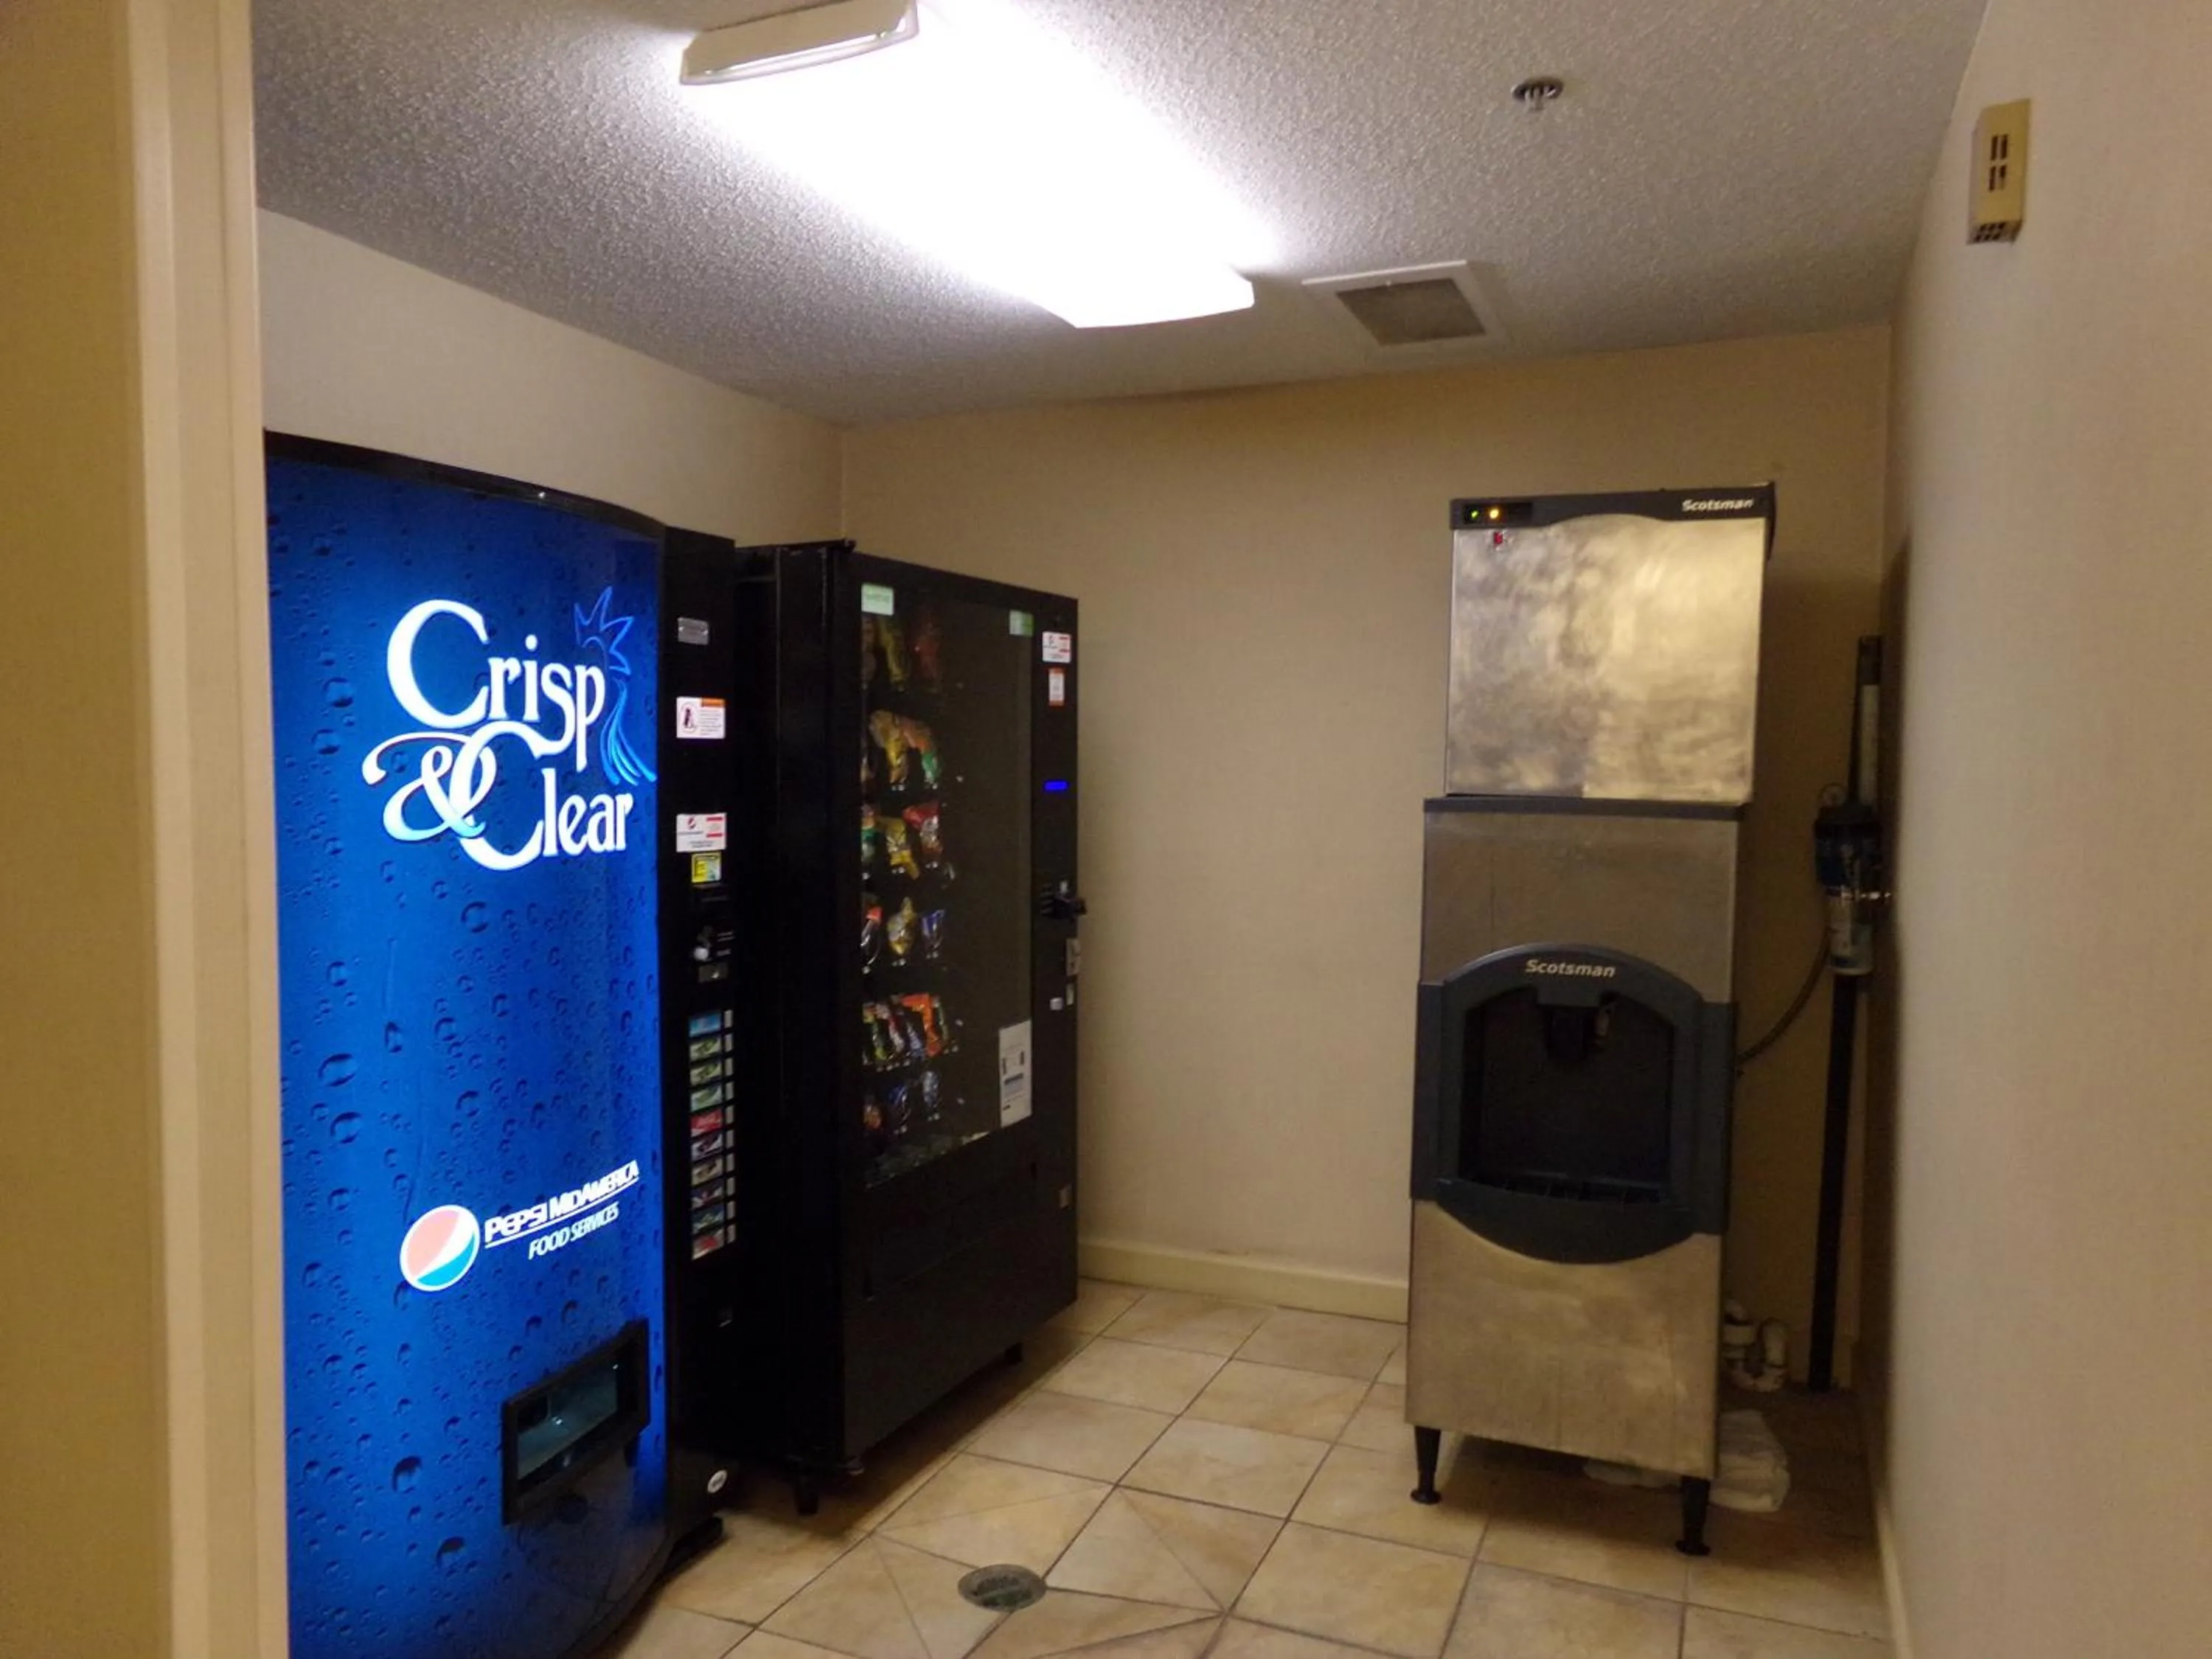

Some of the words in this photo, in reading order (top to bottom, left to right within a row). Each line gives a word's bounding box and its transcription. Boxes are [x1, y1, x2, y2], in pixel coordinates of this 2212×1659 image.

[1682, 498, 1753, 512] Scotsman
[387, 599, 605, 772] Crisp
[362, 731, 496, 841] &
[450, 720, 633, 871] Clear
[1526, 960, 1615, 978] Scotsman
[484, 1203, 548, 1242] PEPSI
[528, 1227, 571, 1260] FOOD
[570, 1201, 619, 1242] SERVICES
